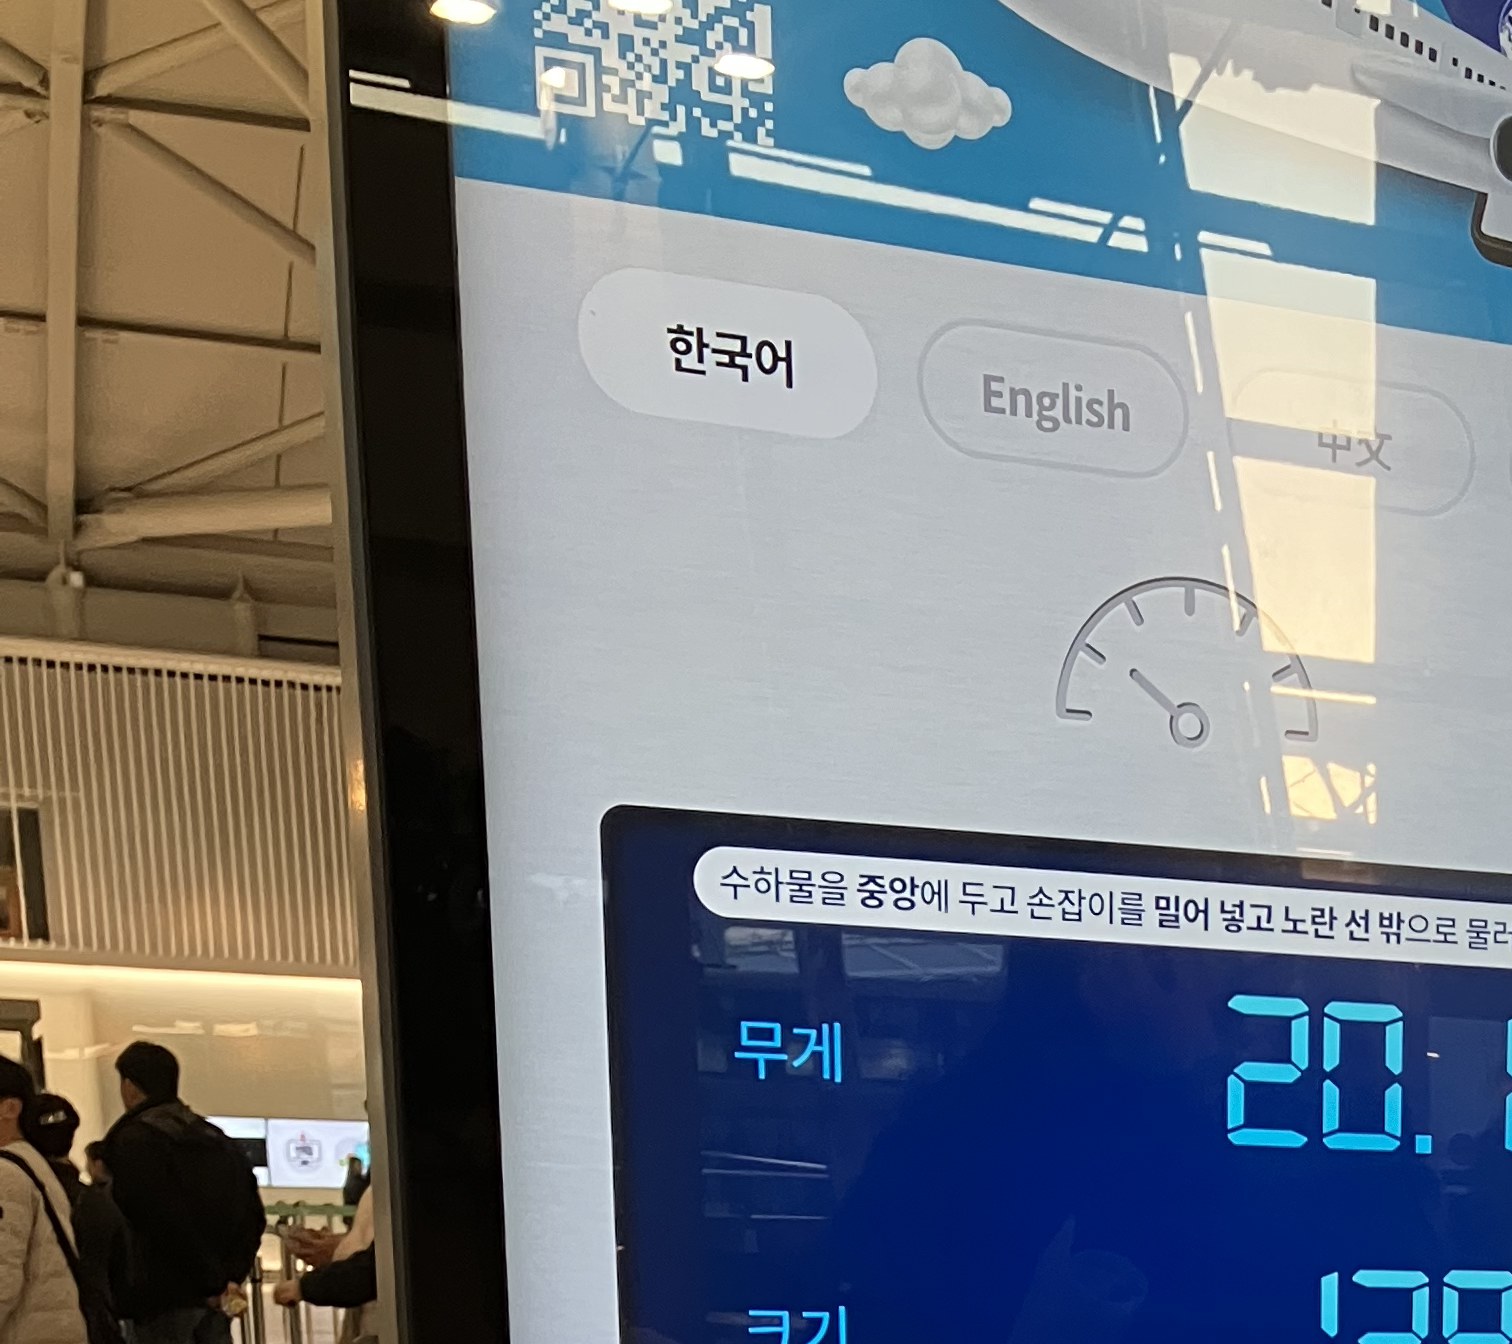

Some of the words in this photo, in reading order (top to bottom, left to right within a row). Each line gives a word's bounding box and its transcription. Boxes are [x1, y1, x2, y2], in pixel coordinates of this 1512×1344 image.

[666, 323, 797, 388] 한국어
[981, 373, 1132, 434] English
[1318, 423, 1394, 472] 中文
[720, 866, 848, 906] 수하물을
[856, 875, 949, 913] 중앙에
[959, 882, 1018, 915] 두고
[1026, 886, 1146, 927] 손잡이를
[1155, 896, 1210, 931] 밀어
[1219, 900, 1274, 934] 넣고
[1281, 906, 1337, 940] 노란
[1344, 909, 1370, 941] 선
[1379, 911, 1458, 946] 밖으로
[733, 1020, 845, 1084] 무게
